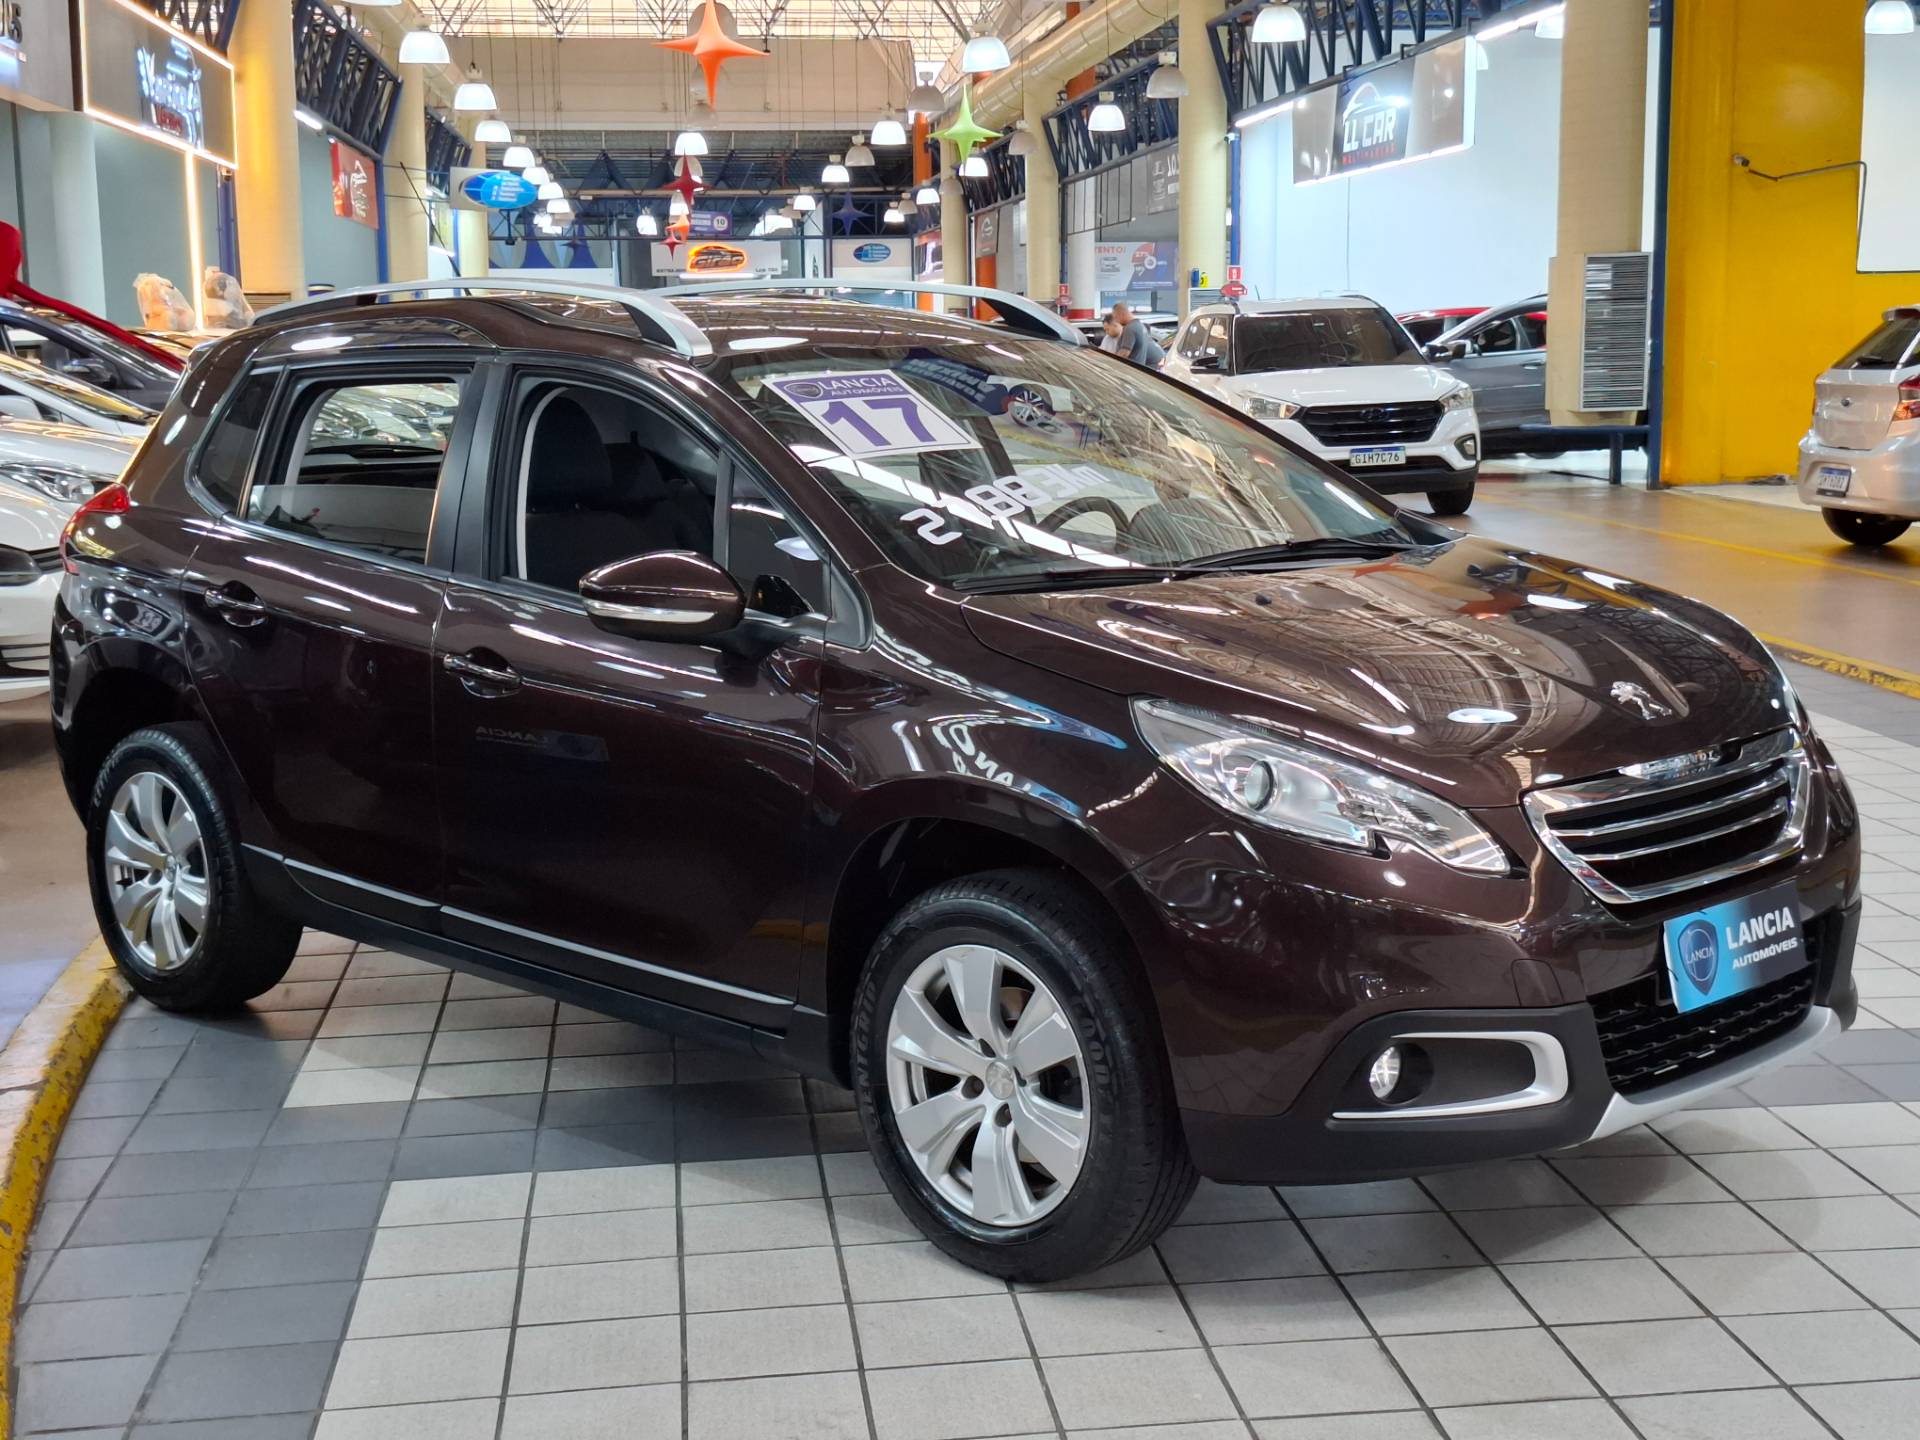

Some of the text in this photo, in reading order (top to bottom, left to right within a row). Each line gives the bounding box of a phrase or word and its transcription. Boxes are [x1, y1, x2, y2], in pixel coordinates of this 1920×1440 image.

[1362, 108, 1396, 147] CAR
[817, 377, 897, 391] LANCIA
[821, 397, 938, 447] 17
[1355, 452, 1400, 464] GIH7C76
[1726, 906, 1795, 950] LANCIA
[1686, 945, 1715, 964] LANCIA
[1732, 937, 1799, 970] AUTOMÓVEIS
